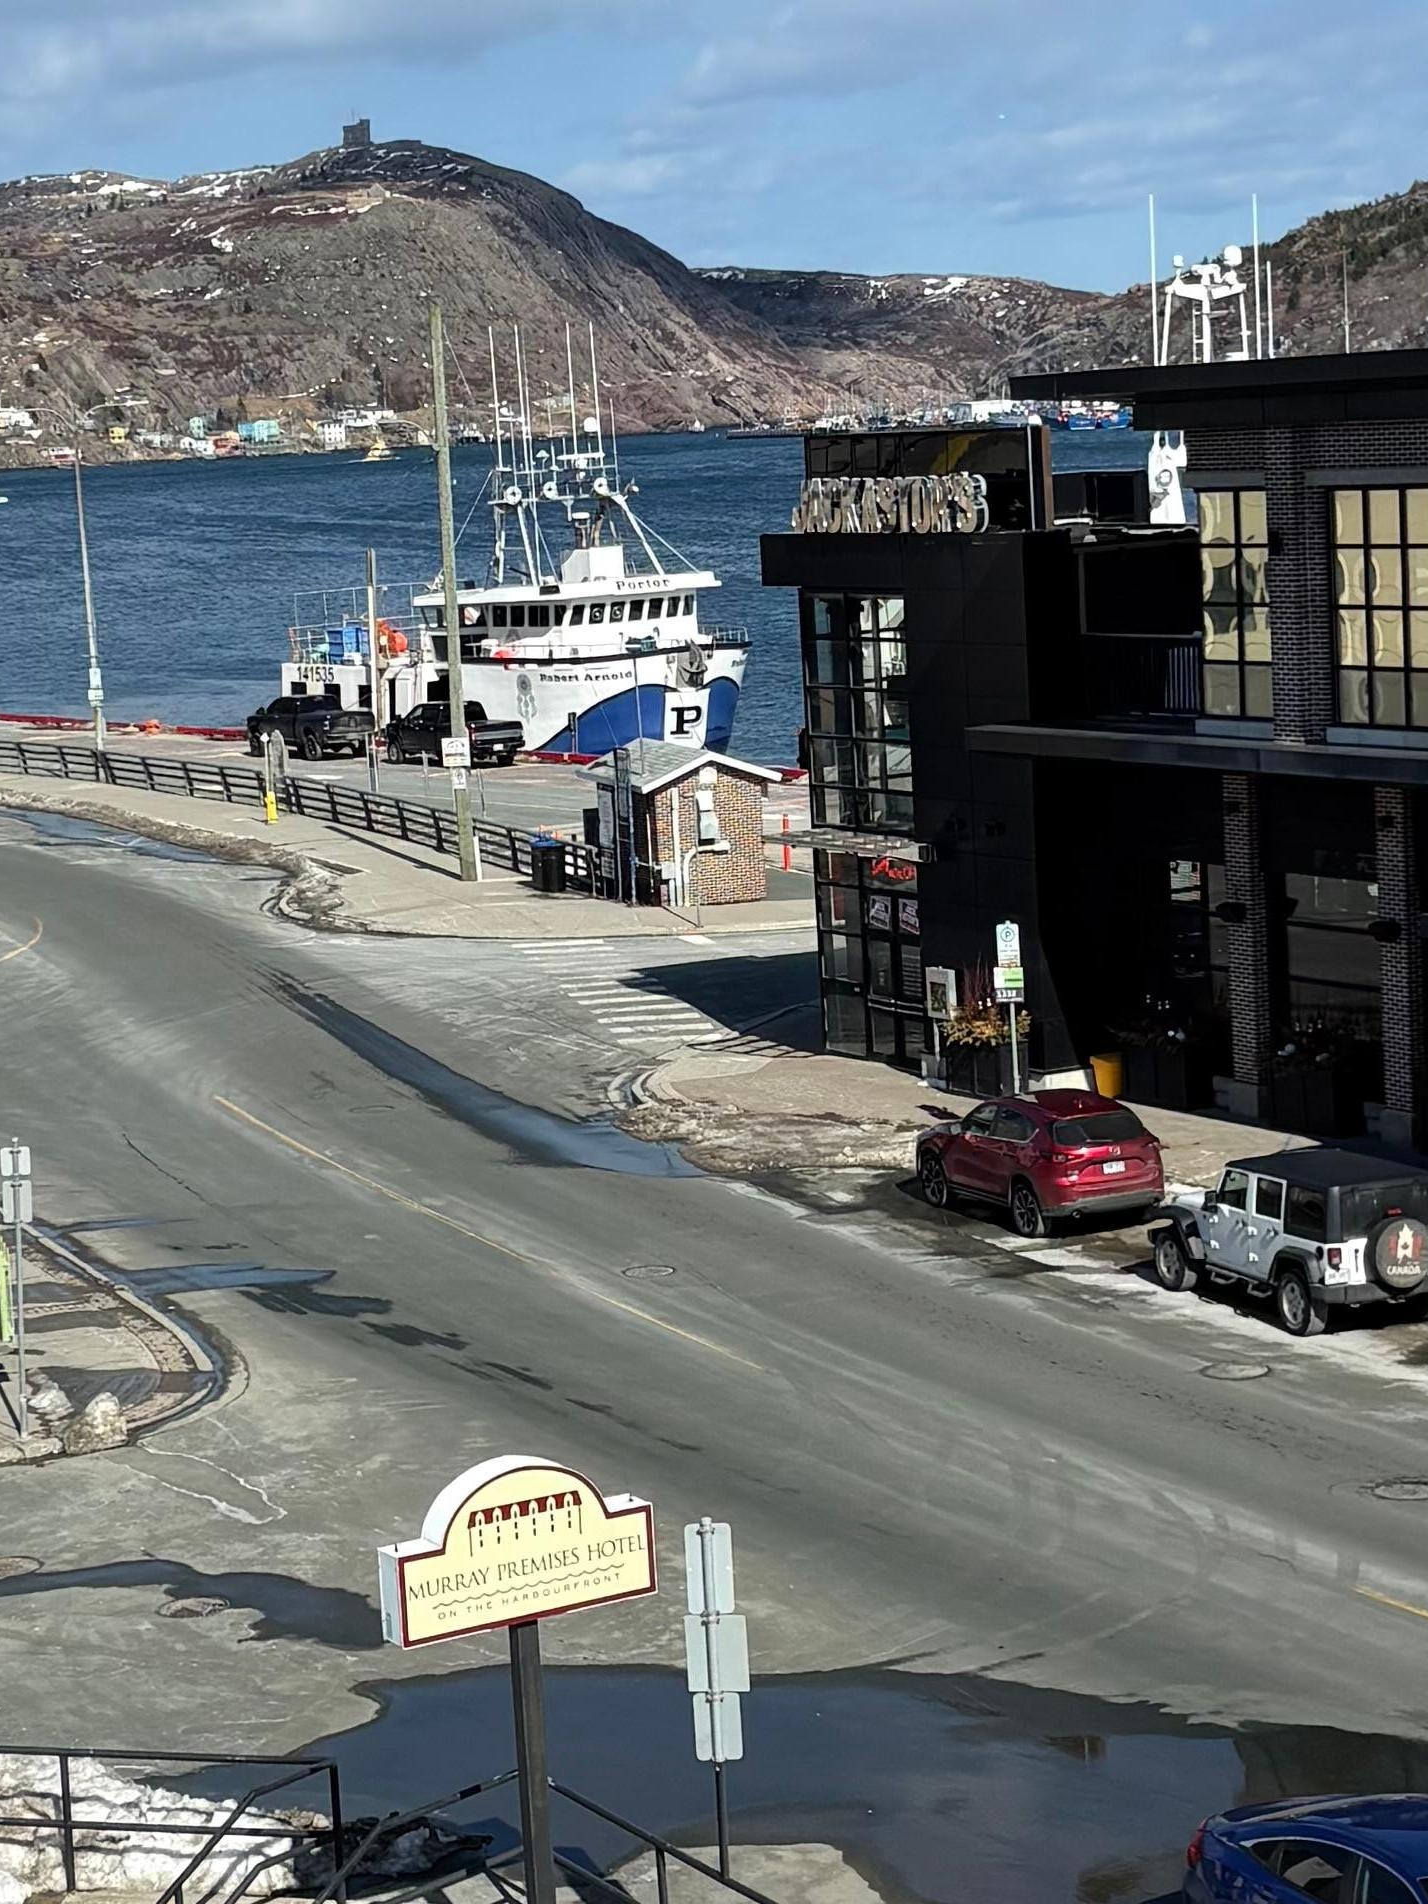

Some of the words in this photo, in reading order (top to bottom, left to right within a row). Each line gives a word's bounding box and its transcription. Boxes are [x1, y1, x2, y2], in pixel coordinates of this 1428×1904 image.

[297, 665, 335, 683] 141535
[583, 670, 633, 683] Arnold
[670, 705, 703, 736] P
[1387, 1264, 1421, 1276] CANADA
[408, 1566, 491, 1602] MURRAY
[497, 1546, 580, 1582] PREMISES
[587, 1534, 646, 1562] HOTEL
[438, 1609, 457, 1620] ON
[466, 1601, 492, 1614] THE
[501, 1572, 620, 1606] HARBOURFRONT
